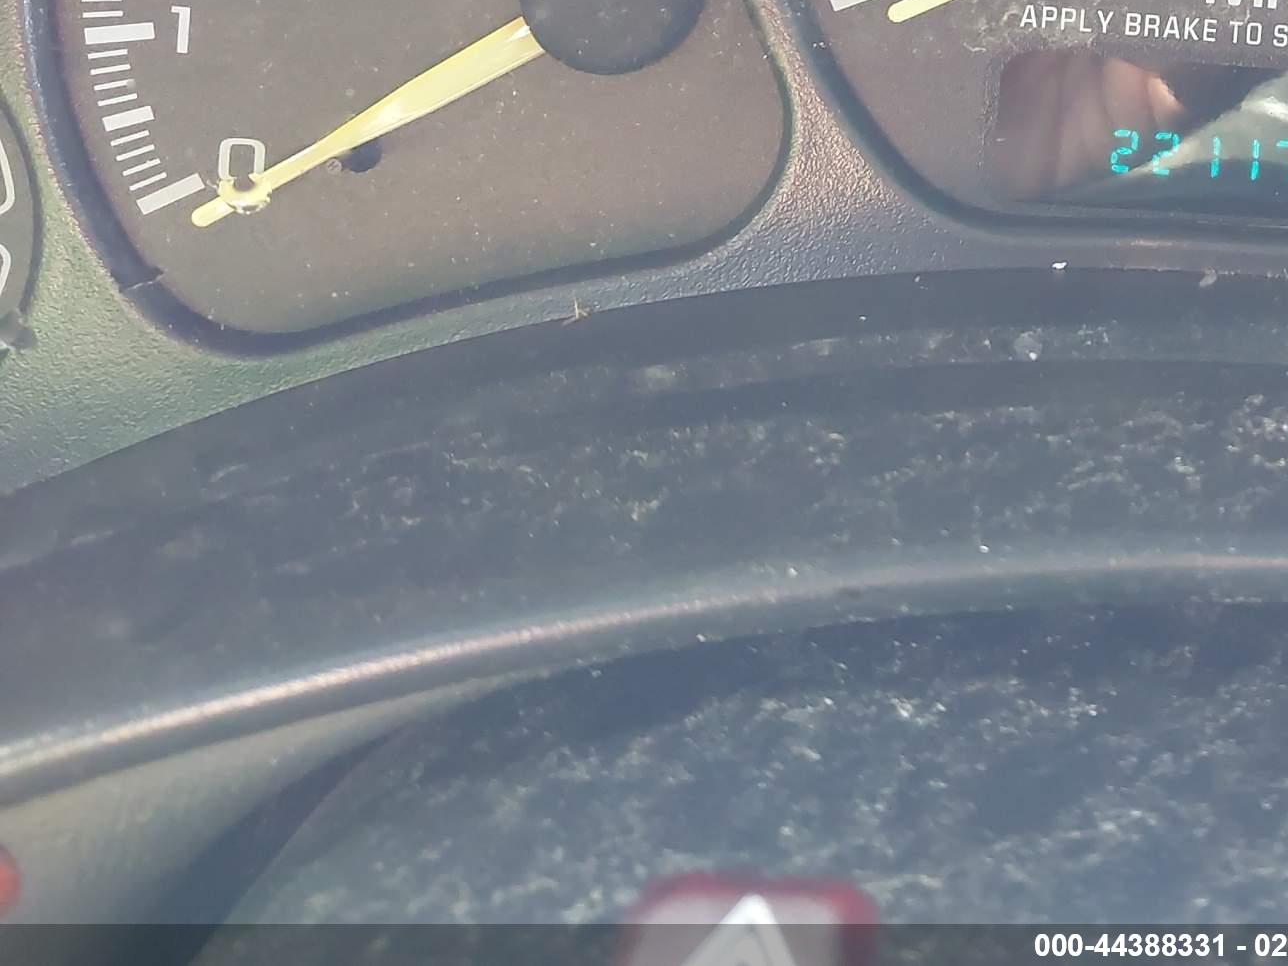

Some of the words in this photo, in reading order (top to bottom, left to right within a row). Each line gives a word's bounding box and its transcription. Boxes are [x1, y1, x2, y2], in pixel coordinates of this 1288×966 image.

[170, 5, 191, 54] 1
[1020, 4, 1114, 33] APPLY
[1125, 12, 1217, 43] BRAKE
[1229, 21, 1262, 46] TO
[218, 138, 266, 182] 0
